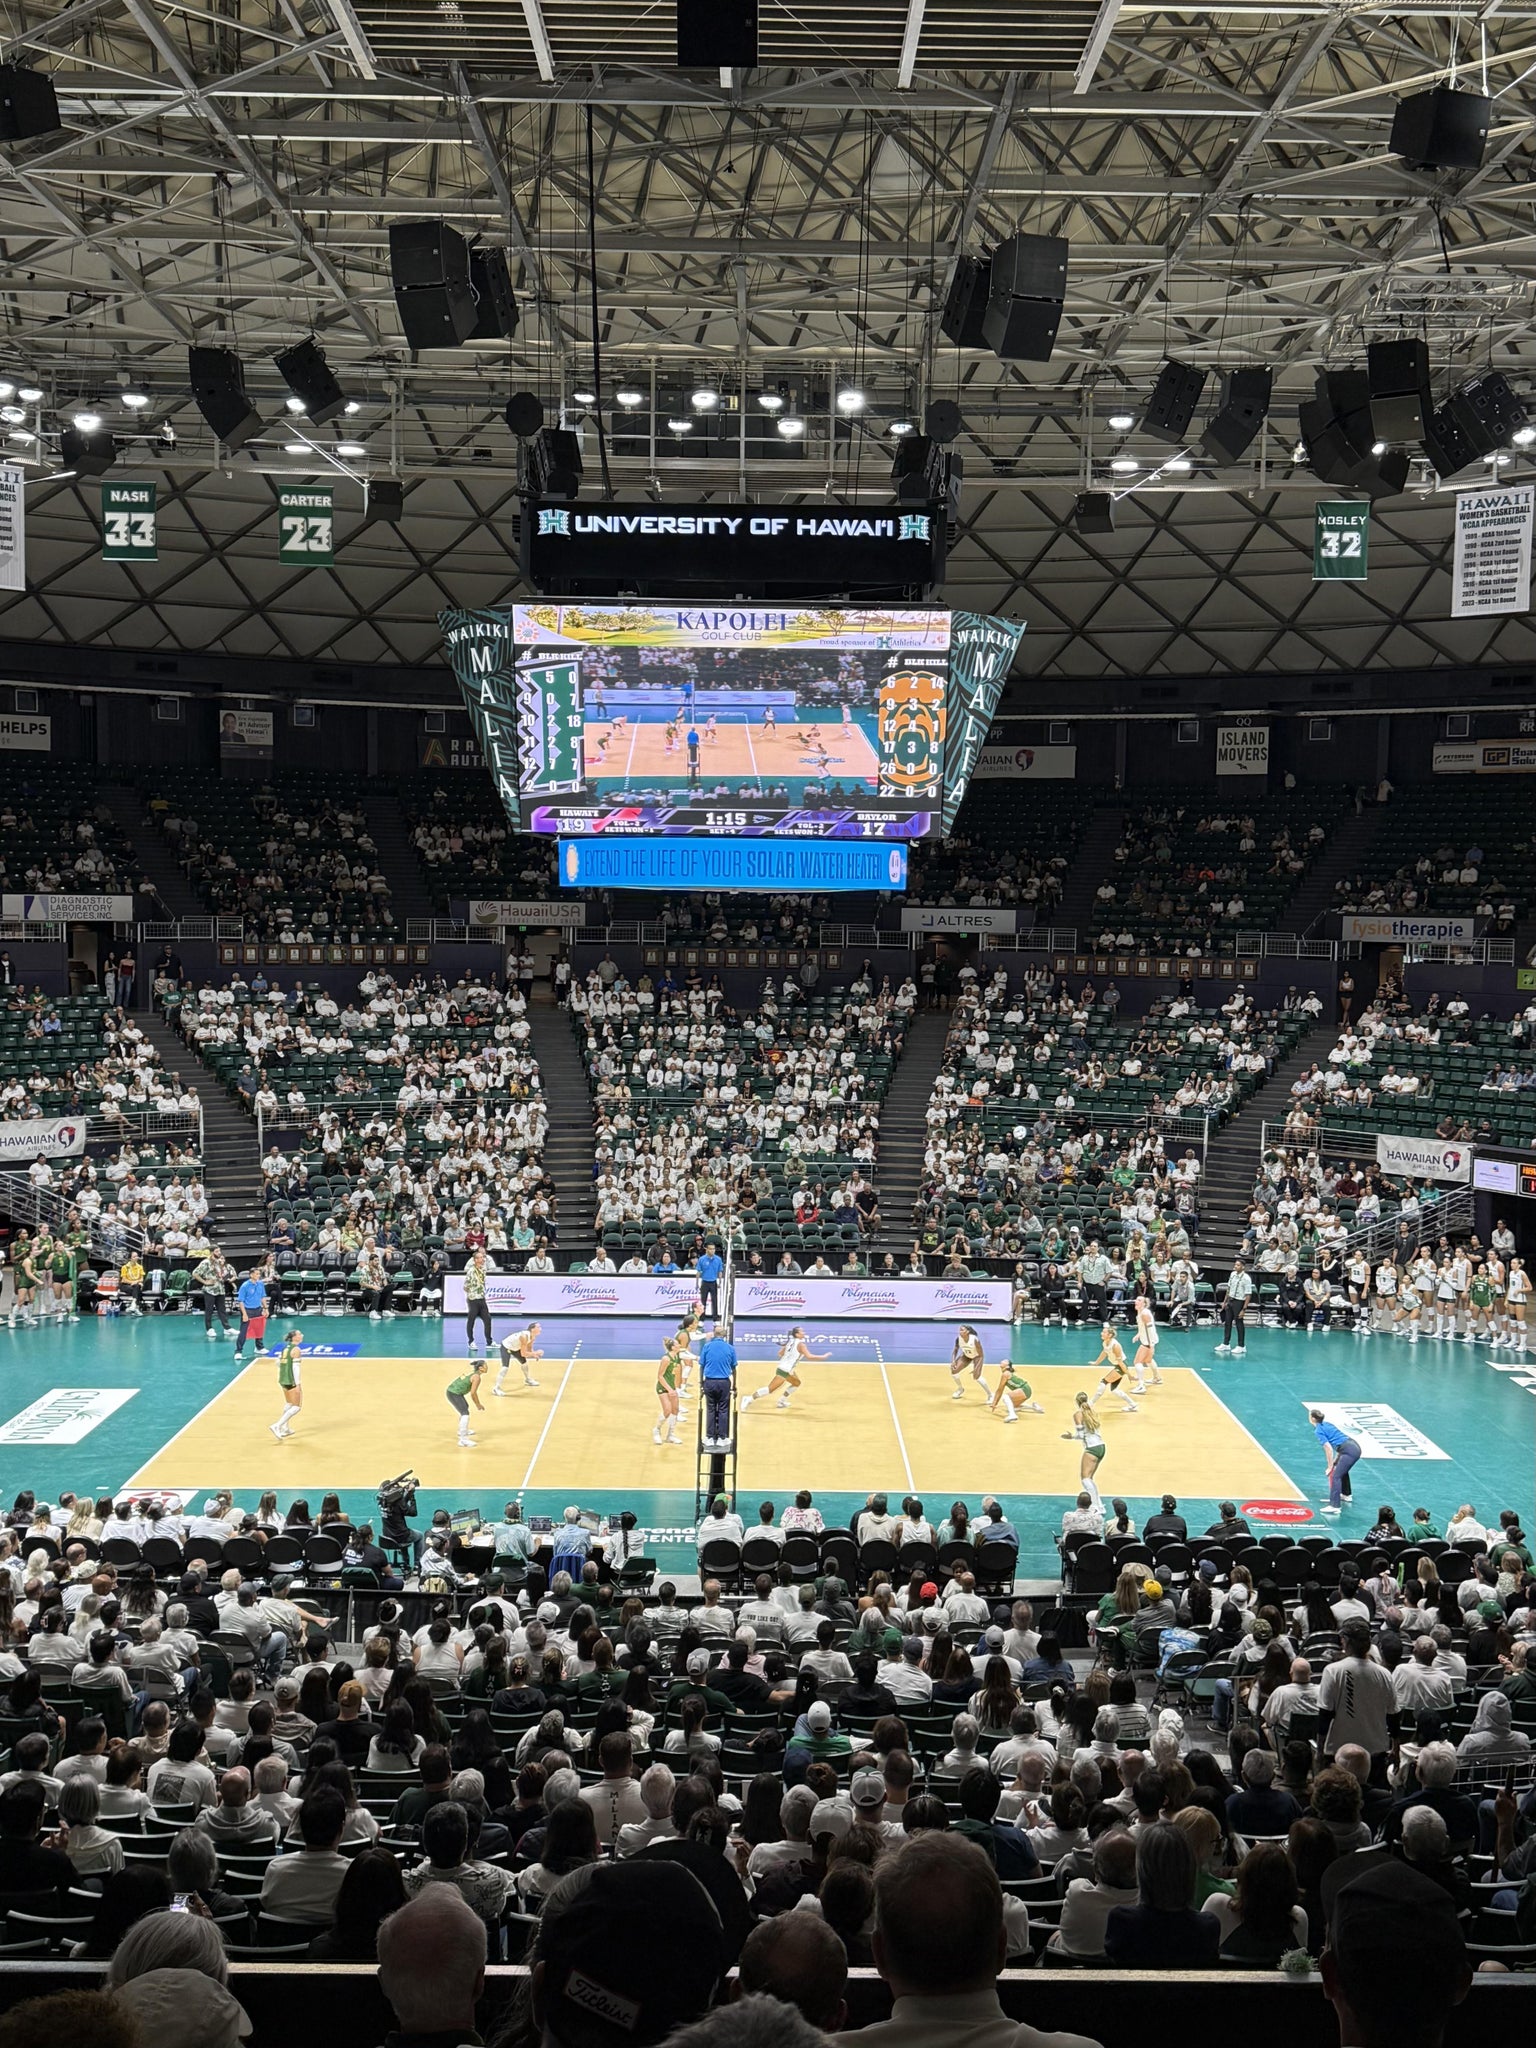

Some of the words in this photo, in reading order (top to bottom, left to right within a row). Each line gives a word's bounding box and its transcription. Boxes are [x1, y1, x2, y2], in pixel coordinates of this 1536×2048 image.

[110, 490, 149, 502] NASH
[280, 494, 332, 507] CARTER
[1459, 508, 1490, 520] WOMEN'S
[1491, 505, 1531, 517] BASKETBALL
[575, 515, 743, 535] UNIVERSITY
[750, 518, 789, 535] OF
[1318, 516, 1367, 526] MOSLEY
[1462, 520, 1480, 530] NCAA
[1481, 515, 1527, 528] APPEARANCES
[104, 512, 156, 547] 33
[280, 516, 332, 552] 23
[1320, 531, 1362, 558] 32
[677, 612, 786, 630] KAPOLEI
[448, 623, 509, 645] WAIKIKI
[702, 632, 731, 640] GOLF
[733, 632, 762, 640] CLUB
[957, 629, 1018, 651] WAIKIKI
[523, 671, 531, 683] 3
[545, 671, 554, 683] 5
[568, 671, 576, 683] 0
[887, 676, 895, 689] 6
[910, 676, 918, 689] 2
[930, 677, 944, 689] 14
[523, 693, 532, 705] 9
[546, 693, 555, 704] 0
[569, 693, 576, 705] 7
[887, 698, 895, 710] 9
[909, 698, 918, 711] 3
[932, 699, 940, 711] 2
[470, 646, 517, 798] MALIA
[521, 714, 535, 726] 10
[547, 715, 555, 727] 2
[567, 715, 581, 727] 18
[884, 720, 897, 732] 12
[908, 720, 917, 732] 4
[932, 720, 939, 732] 1
[948, 651, 996, 801] MALIA
[1236, 717, 1252, 726] QQ
[523, 736, 535, 748] 11
[547, 736, 556, 748] 2
[570, 737, 578, 748] 8
[1222, 731, 1265, 746] ISLAND
[883, 741, 896, 753] 17
[907, 741, 916, 753] 3
[930, 741, 938, 754] 8
[1218, 747, 1268, 761] MOVERS
[523, 758, 537, 769] 12
[549, 758, 556, 770] 7
[571, 758, 578, 770] 7
[881, 762, 896, 775] 26
[906, 762, 915, 775] 0
[929, 762, 937, 775] 0
[526, 780, 534, 792] 2
[549, 780, 557, 792] 0
[572, 781, 580, 793] 0
[880, 785, 895, 797] 22
[906, 785, 914, 797] 0
[928, 785, 936, 797] 0
[562, 819, 585, 832] 19
[706, 812, 746, 826] 1:15
[862, 823, 886, 836] 17
[585, 850, 620, 877] EXTEND
[625, 850, 645, 877] THE
[650, 850, 675, 877] LIFE
[681, 850, 698, 877] OF
[702, 850, 742, 878] YOUR
[747, 851, 795, 878] SOLAR
[801, 851, 843, 879] WATER
[50, 896, 113, 904] DIAGNOSTIC
[50, 904, 113, 912] LABORATORY
[500, 904, 581, 917] HawaiiUSA
[937, 916, 993, 926] ALTRES
[1352, 918, 1463, 940] fysiotherapie
[0, 1134, 56, 1147] HAWAIIAN
[1387, 1150, 1440, 1165] HAWAIIAN
[485, 1285, 522, 1298] ynesian
[561, 1284, 616, 1299] Polynesian
[748, 1286, 802, 1301] Polynesian
[841, 1287, 895, 1302] Polynesian
[934, 1289, 988, 1303] Polynesian
[1246, 1507, 1307, 1516] Coca-Cola
